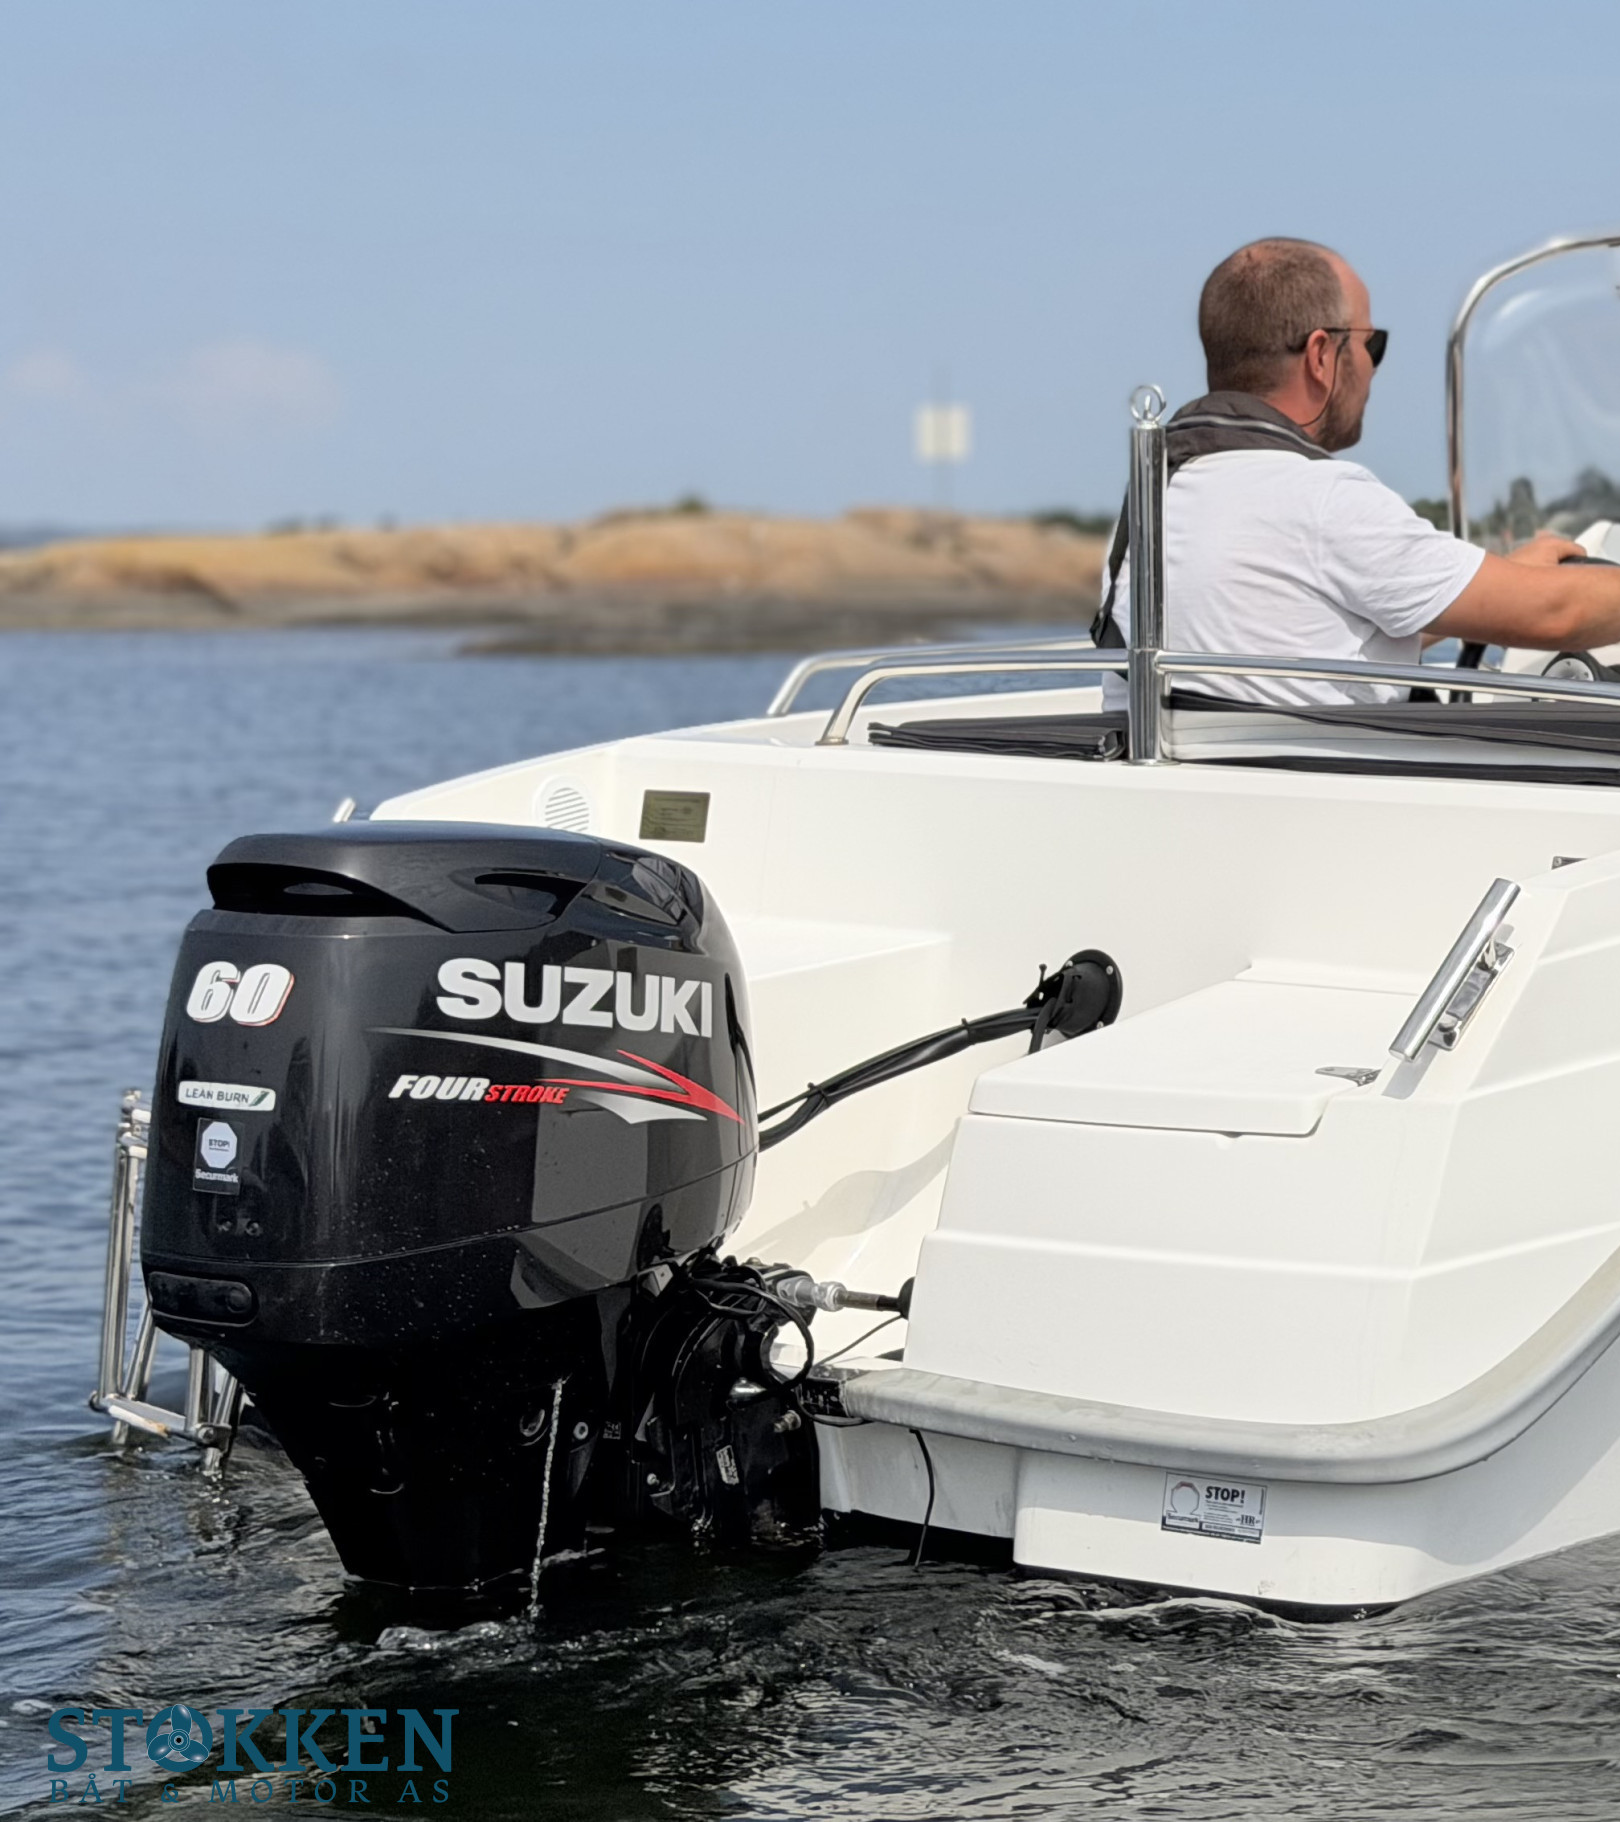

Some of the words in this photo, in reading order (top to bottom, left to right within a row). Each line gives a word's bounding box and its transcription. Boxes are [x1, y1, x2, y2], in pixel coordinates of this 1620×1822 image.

[186, 961, 295, 1027] 60
[436, 957, 713, 1039] SUZUKI
[185, 1088, 214, 1100] LEAN
[216, 1091, 250, 1103] BURN
[388, 1074, 491, 1101] FOUR
[484, 1084, 570, 1105] STROKE
[1205, 1485, 1246, 1504] STOP!
